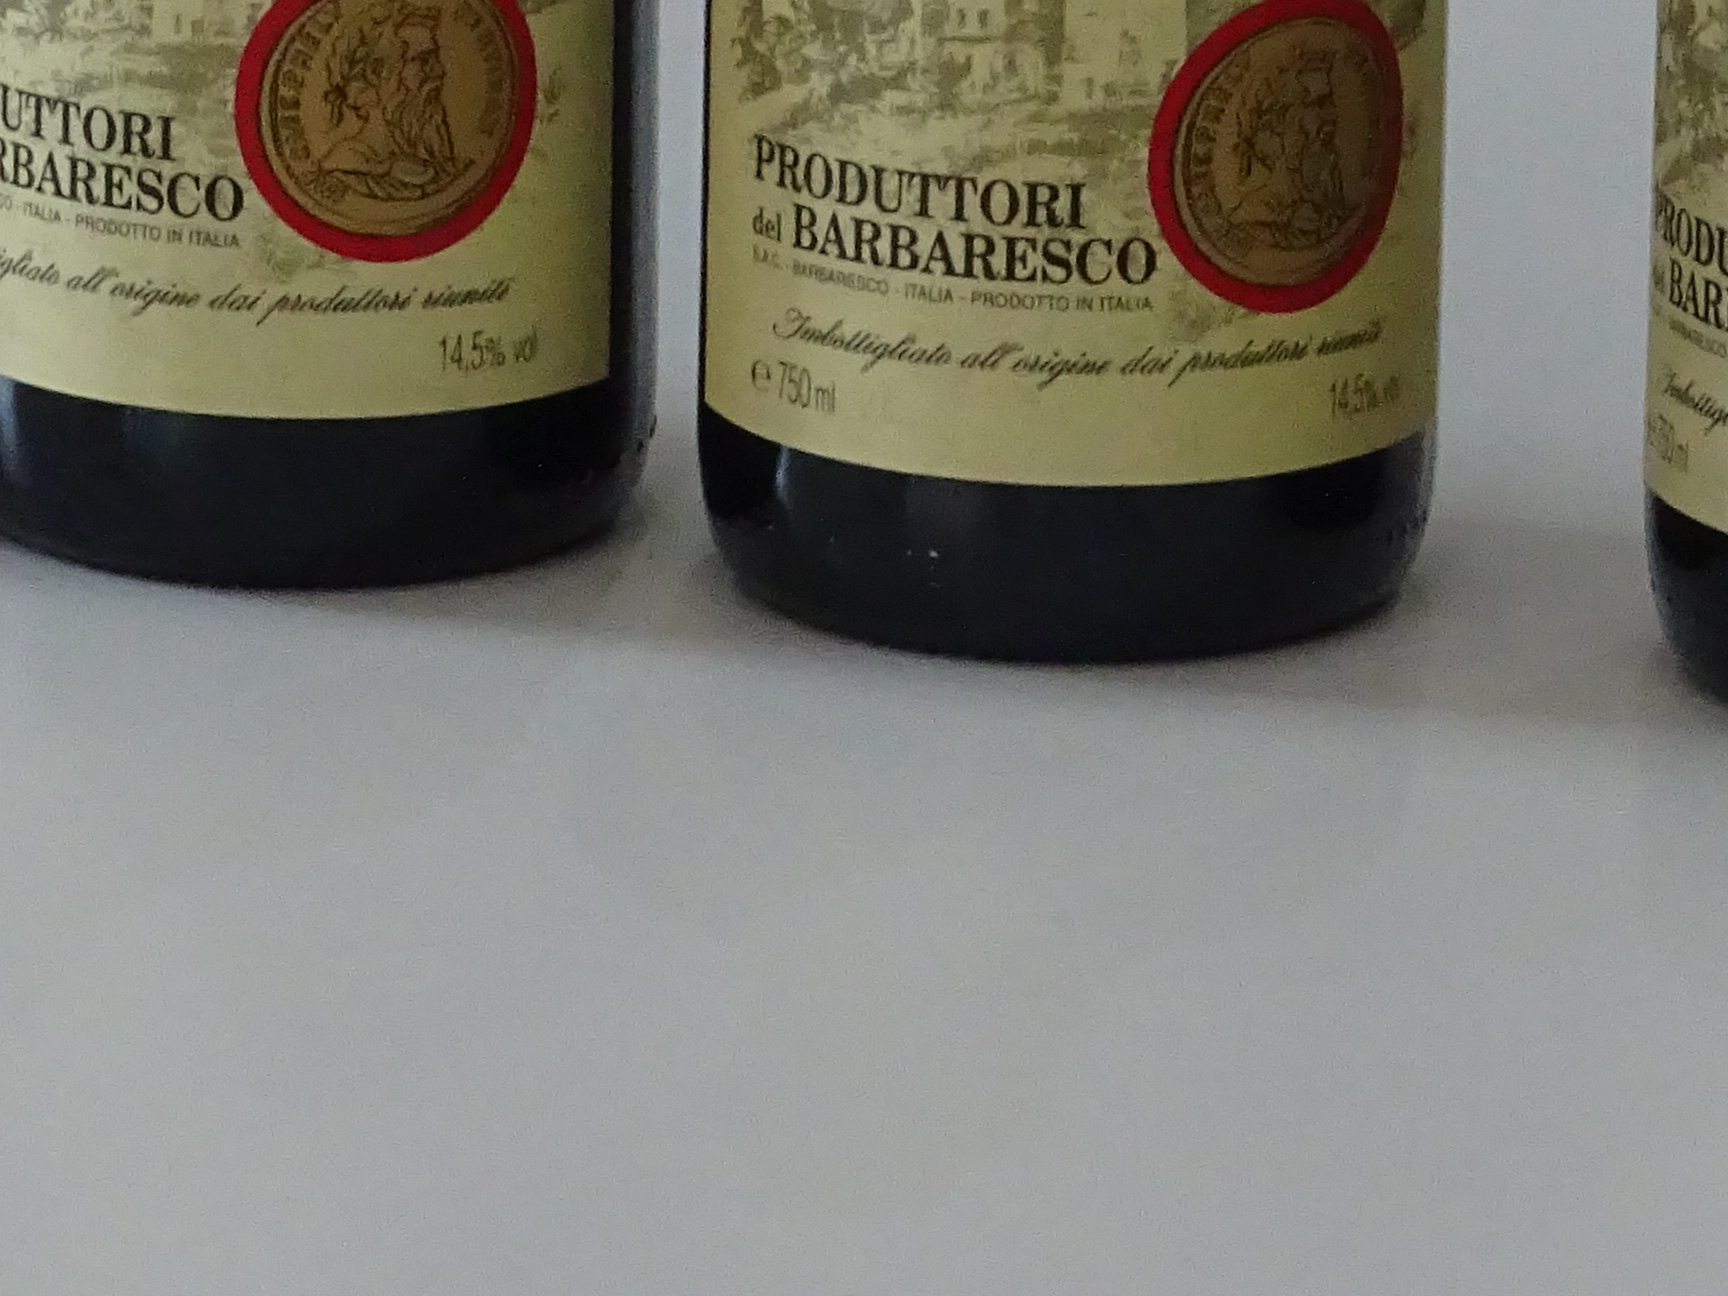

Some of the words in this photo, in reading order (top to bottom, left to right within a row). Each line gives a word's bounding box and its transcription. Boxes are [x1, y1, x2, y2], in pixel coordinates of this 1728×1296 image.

[751, 131, 1088, 230] PRODUTTORI
[75, 213, 163, 243] PRODOTTO
[166, 227, 184, 246] IN
[188, 228, 241, 250] ITALIA
[751, 206, 782, 244] del
[791, 201, 1159, 286] BARBARESCO
[207, 283, 267, 314] dai
[904, 283, 955, 305] ITALIA
[970, 289, 1068, 313] PRODOTTO
[1075, 294, 1094, 312] IN
[1099, 293, 1153, 313] ITALIA
[1118, 345, 1179, 377] dai
[778, 359, 813, 410] 750
[814, 380, 837, 414] ml
